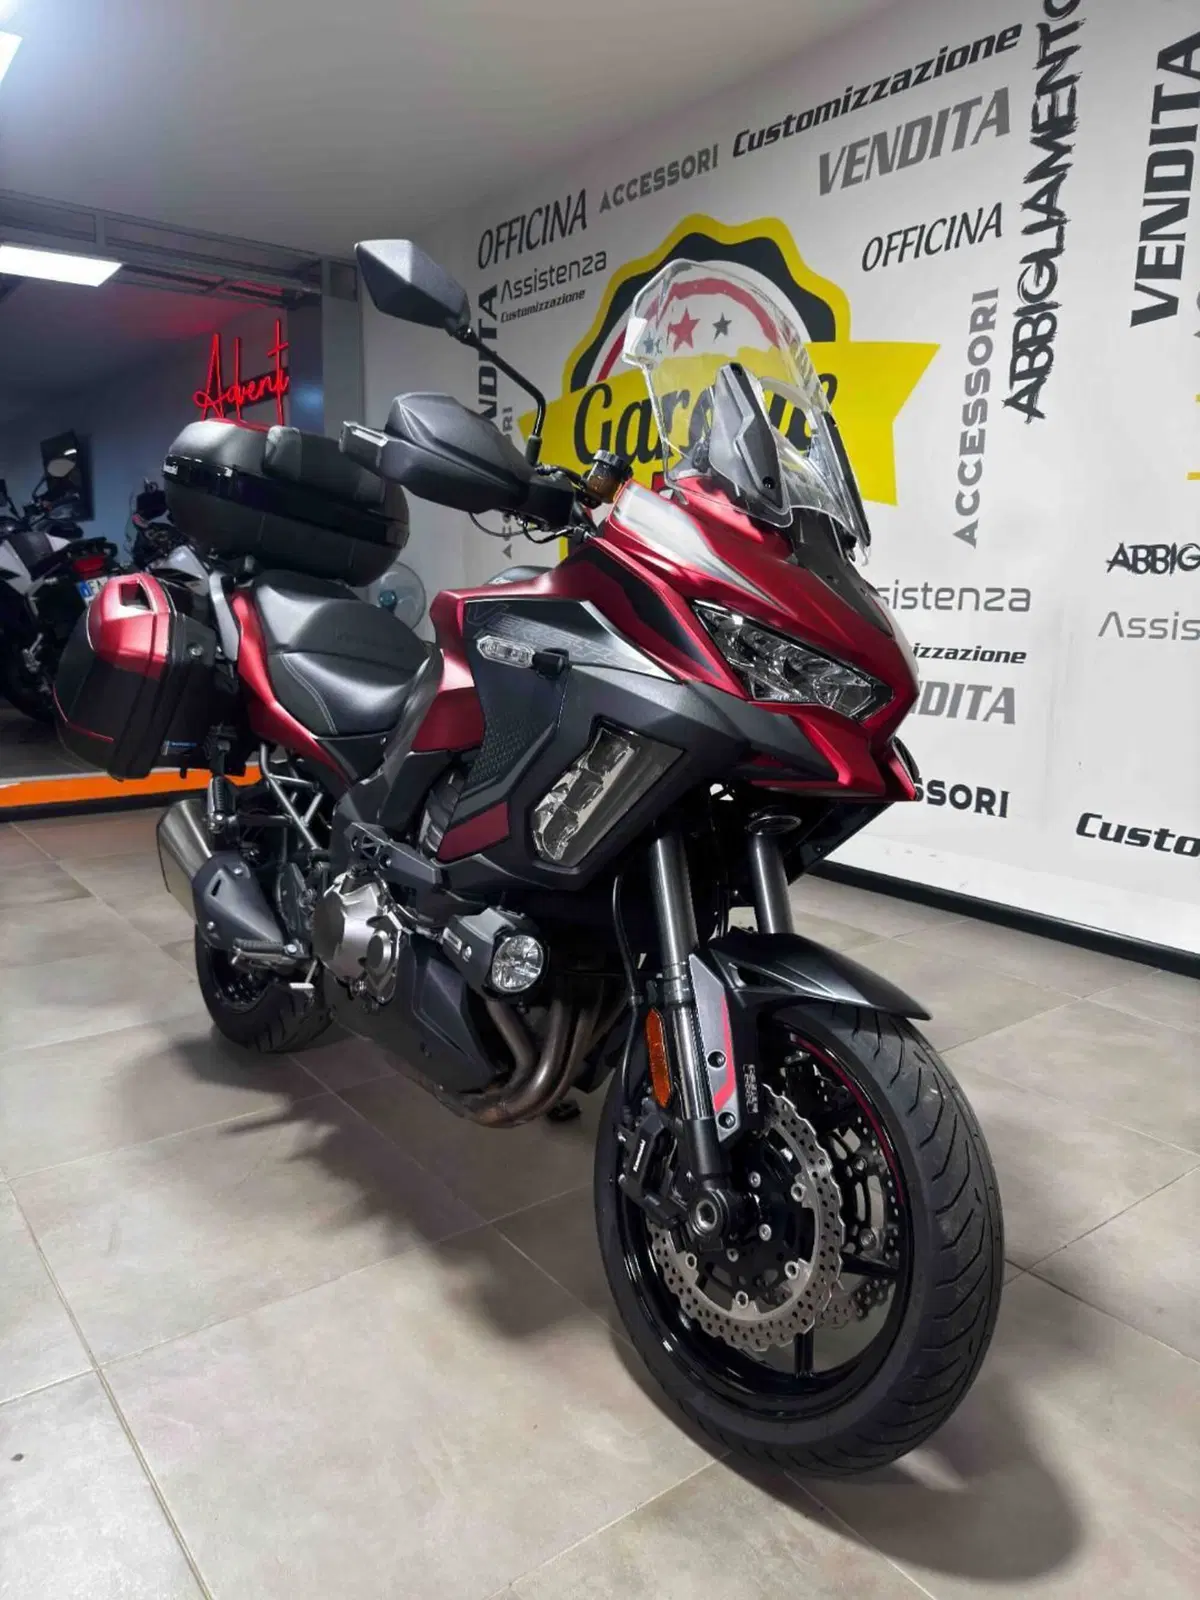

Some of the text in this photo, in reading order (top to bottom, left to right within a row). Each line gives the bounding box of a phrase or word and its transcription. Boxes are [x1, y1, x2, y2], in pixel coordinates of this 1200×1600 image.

[732, 23, 1023, 158] Customizzazione
[819, 86, 1011, 196] VENDITA
[599, 144, 719, 213] ACCESSORI
[478, 188, 588, 270] OFFICINA
[862, 202, 1003, 271] OFFICINA
[500, 250, 607, 304] Assistenza
[501, 289, 586, 323] Customizzazione
[953, 288, 999, 548] ACCESSORI
[1106, 543, 1200, 576] ABBIG
[1097, 611, 1200, 641] Assis
[1077, 812, 1200, 858] Custo
